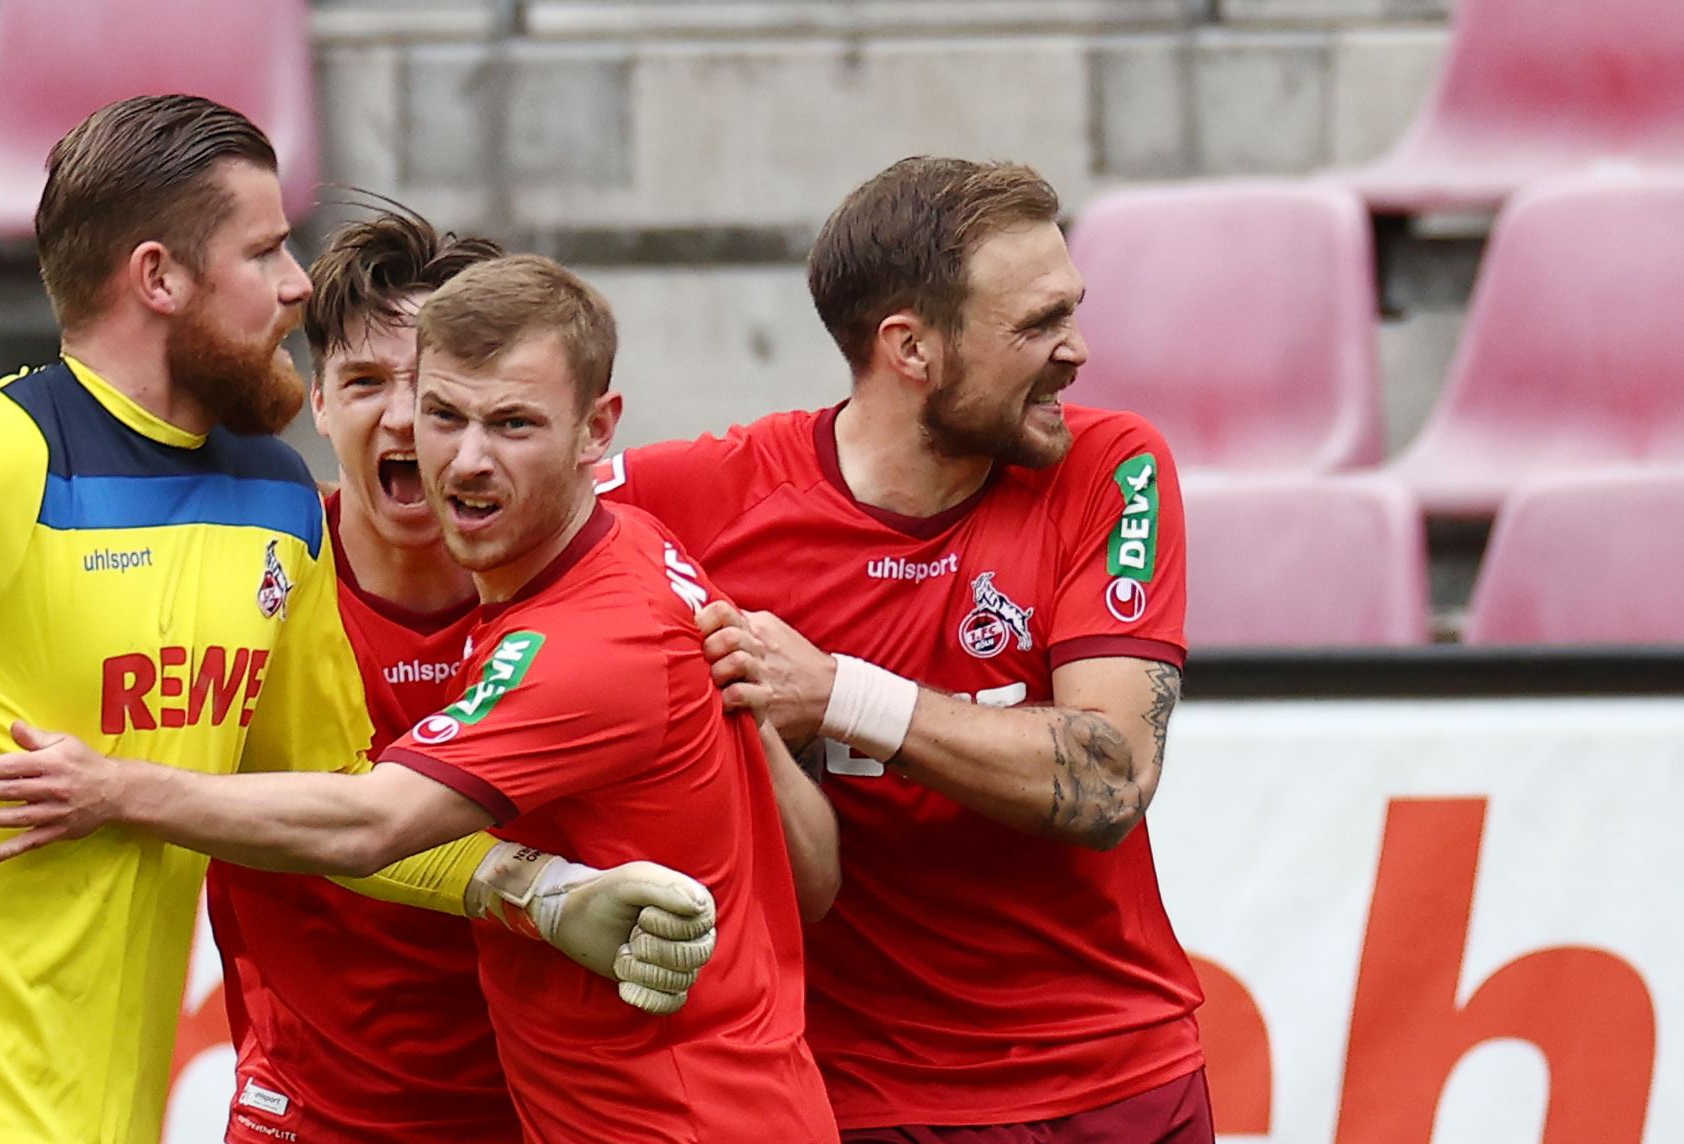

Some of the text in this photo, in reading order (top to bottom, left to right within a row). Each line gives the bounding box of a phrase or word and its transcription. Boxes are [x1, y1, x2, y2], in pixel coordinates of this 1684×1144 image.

[1119, 464, 1153, 570] DEVK
[83, 547, 153, 574] uhlsport
[867, 552, 958, 585] uhlsport
[100, 645, 271, 735] REWE
